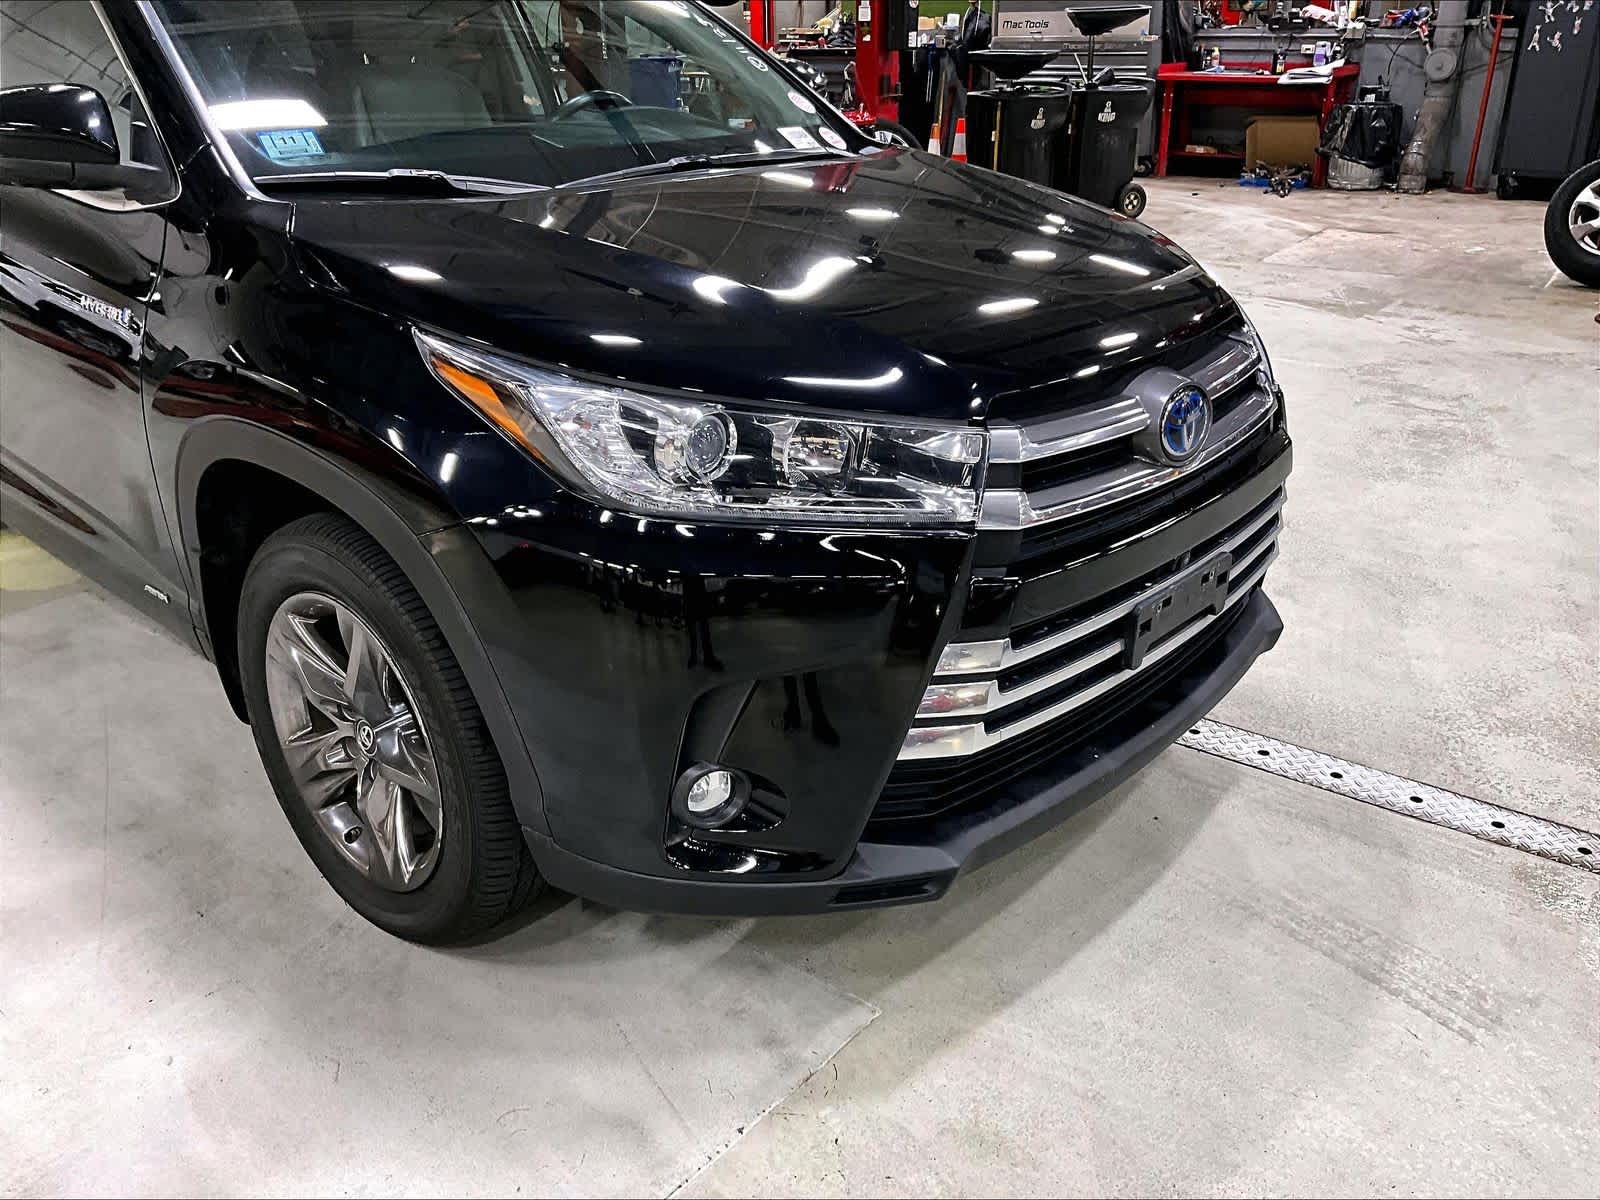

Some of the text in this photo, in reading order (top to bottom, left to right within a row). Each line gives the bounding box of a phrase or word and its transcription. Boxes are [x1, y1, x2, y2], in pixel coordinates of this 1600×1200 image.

[1002, 19, 1049, 29] Mac Tools
[1098, 112, 1116, 122] KING
